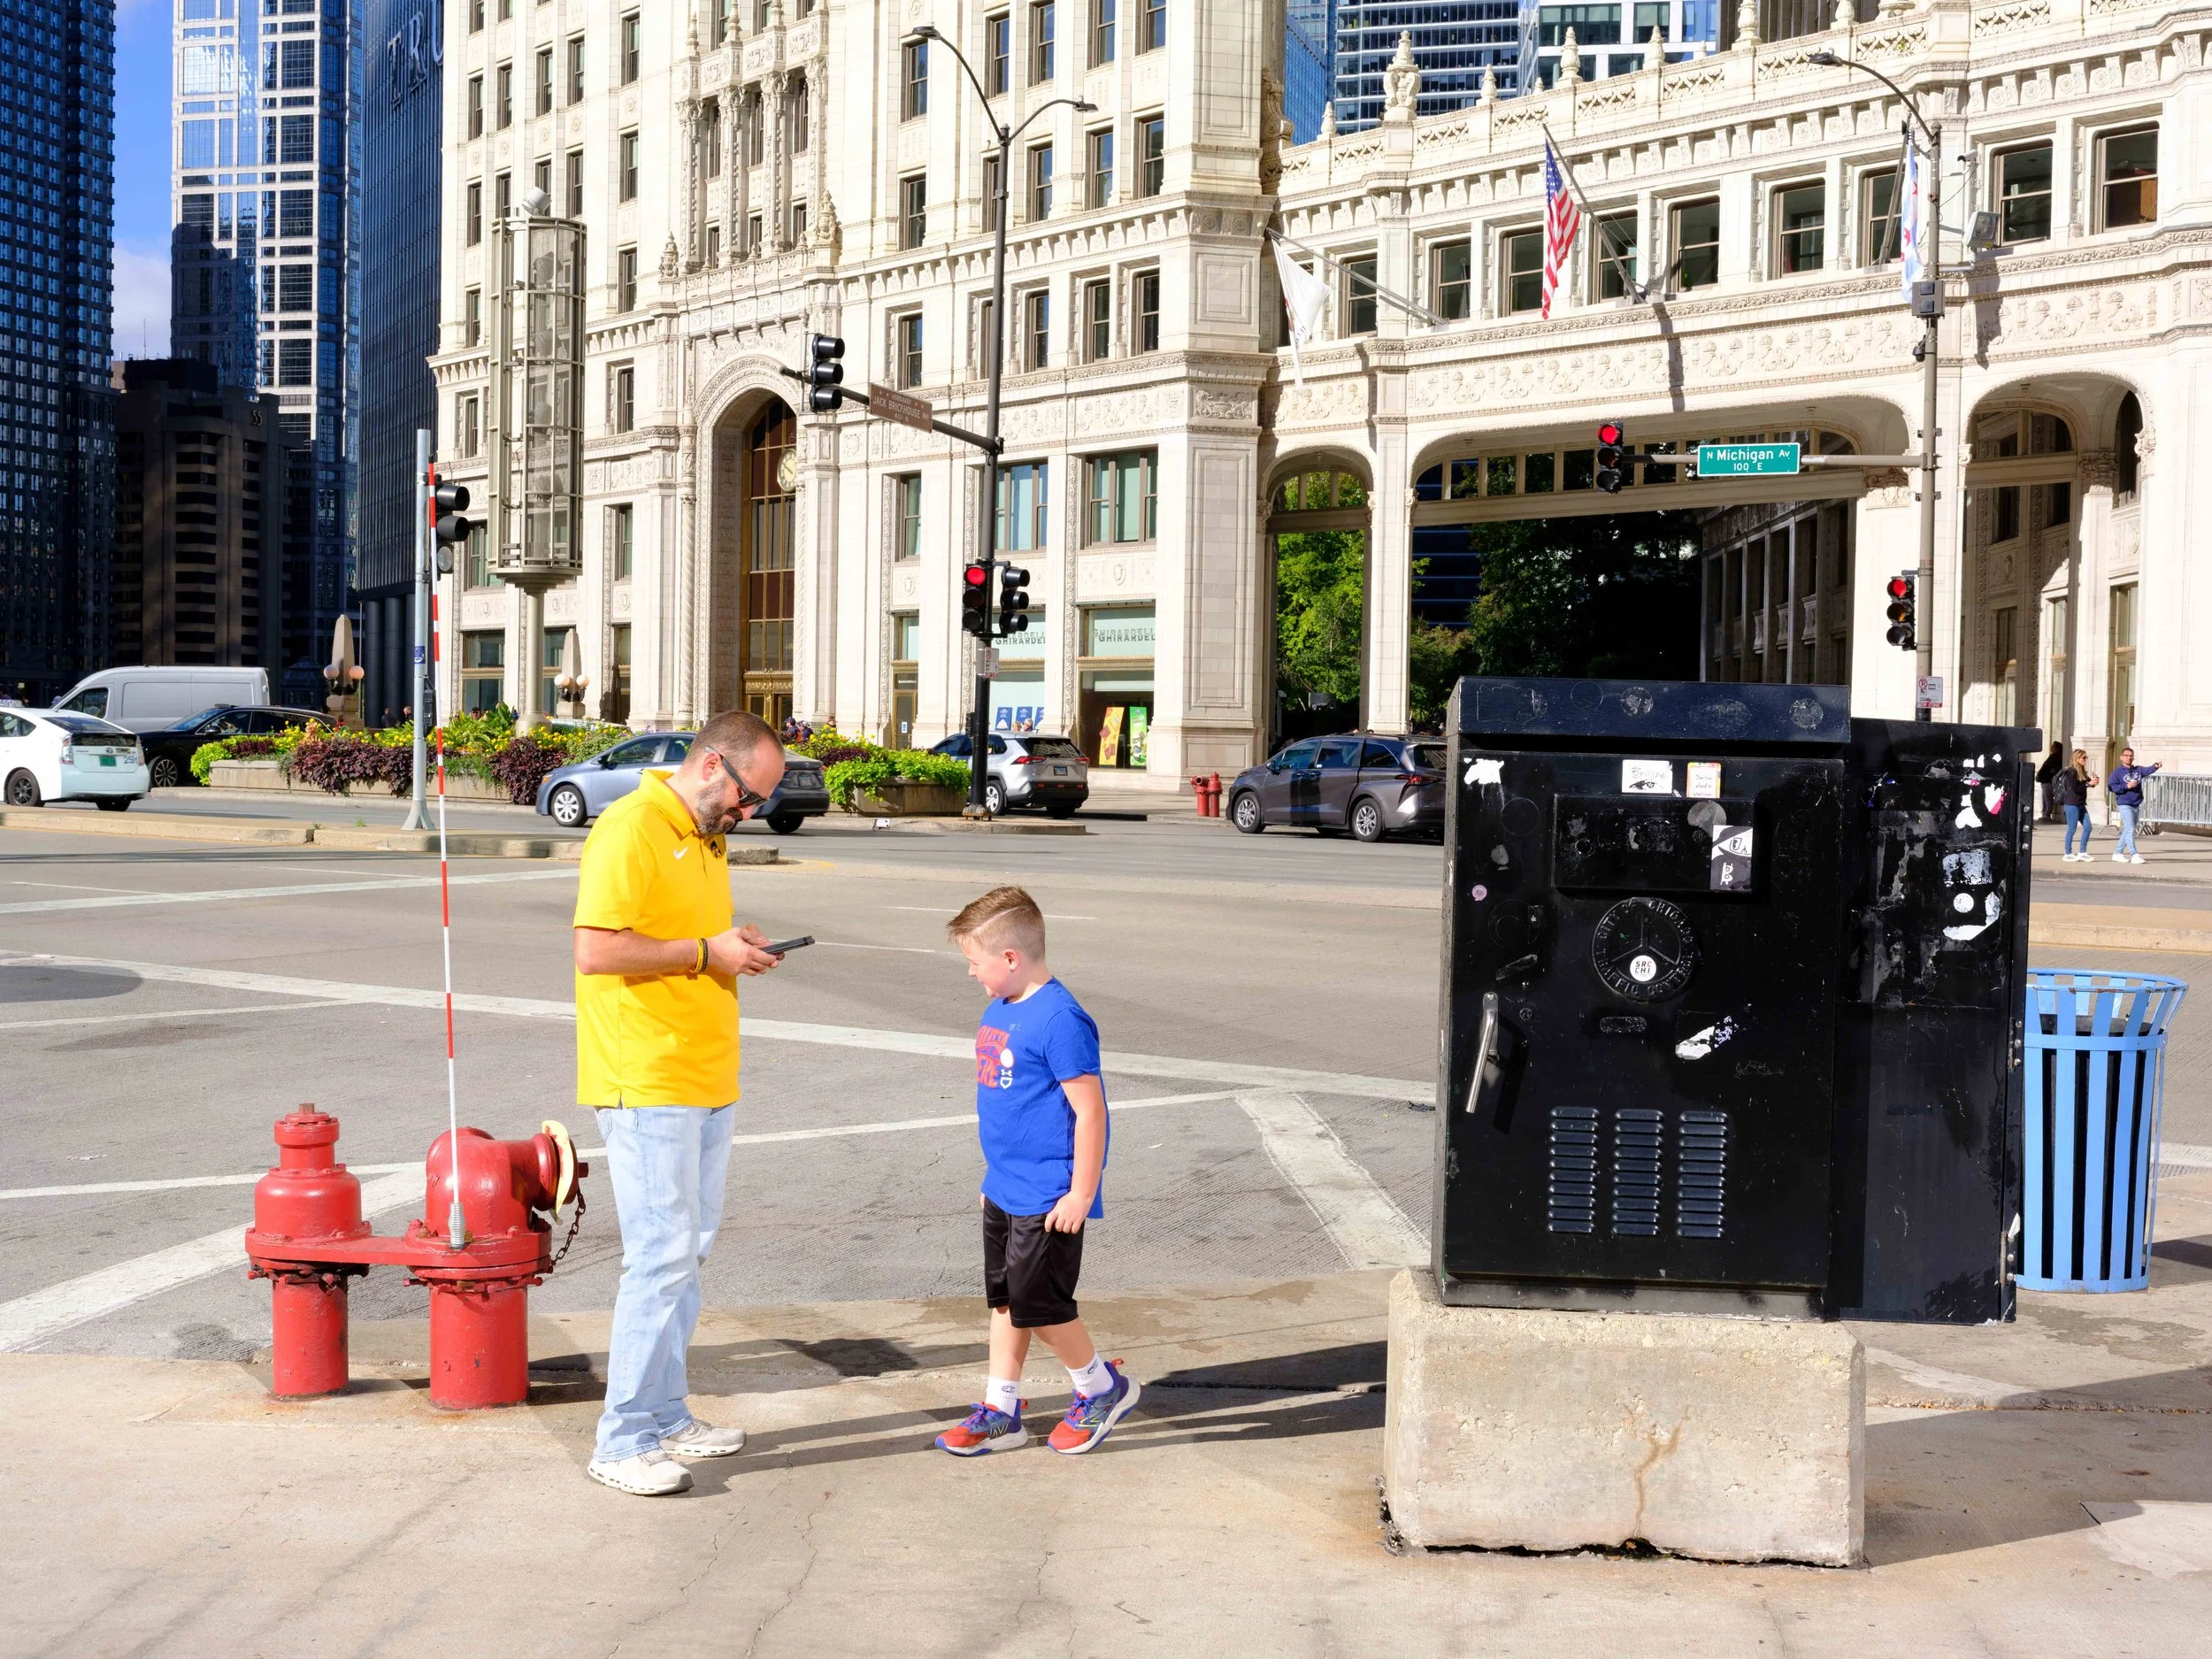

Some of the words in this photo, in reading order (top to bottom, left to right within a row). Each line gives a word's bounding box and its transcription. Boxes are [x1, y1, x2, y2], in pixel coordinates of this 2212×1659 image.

[872, 396, 887, 407] JACK
[888, 400, 921, 419] BRICKHOUSE
[1707, 451, 1714, 460] N
[1717, 449, 1774, 463] Michigan
[1778, 449, 1790, 457] Av
[1757, 462, 1763, 471] E
[1597, 910, 1621, 939] CITY
[1647, 900, 1694, 943] CHICAGO
